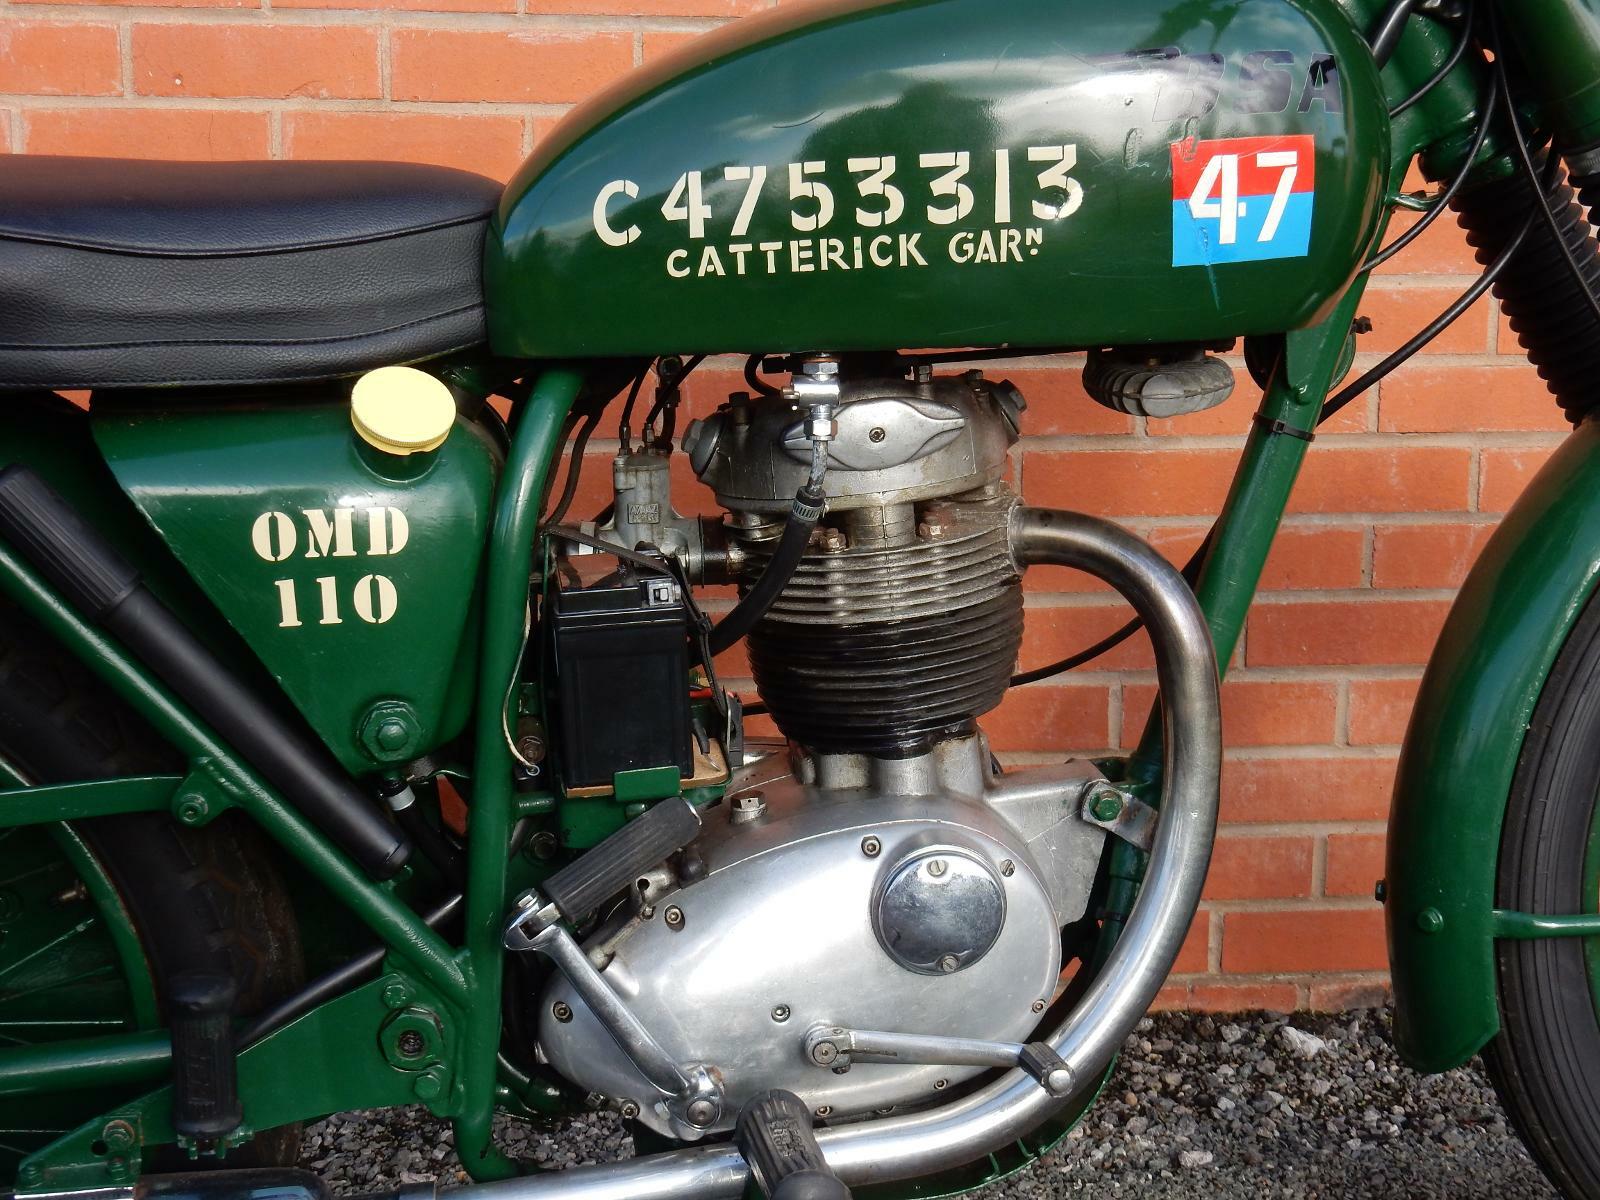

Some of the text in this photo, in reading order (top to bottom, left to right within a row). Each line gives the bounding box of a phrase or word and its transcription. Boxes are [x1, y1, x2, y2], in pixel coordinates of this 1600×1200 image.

[1151, 50, 1344, 122] BSA
[1188, 151, 1298, 244] 47
[666, 232, 929, 278] CATTERICK
[252, 506, 410, 562] OMD
[274, 574, 398, 628] 110
